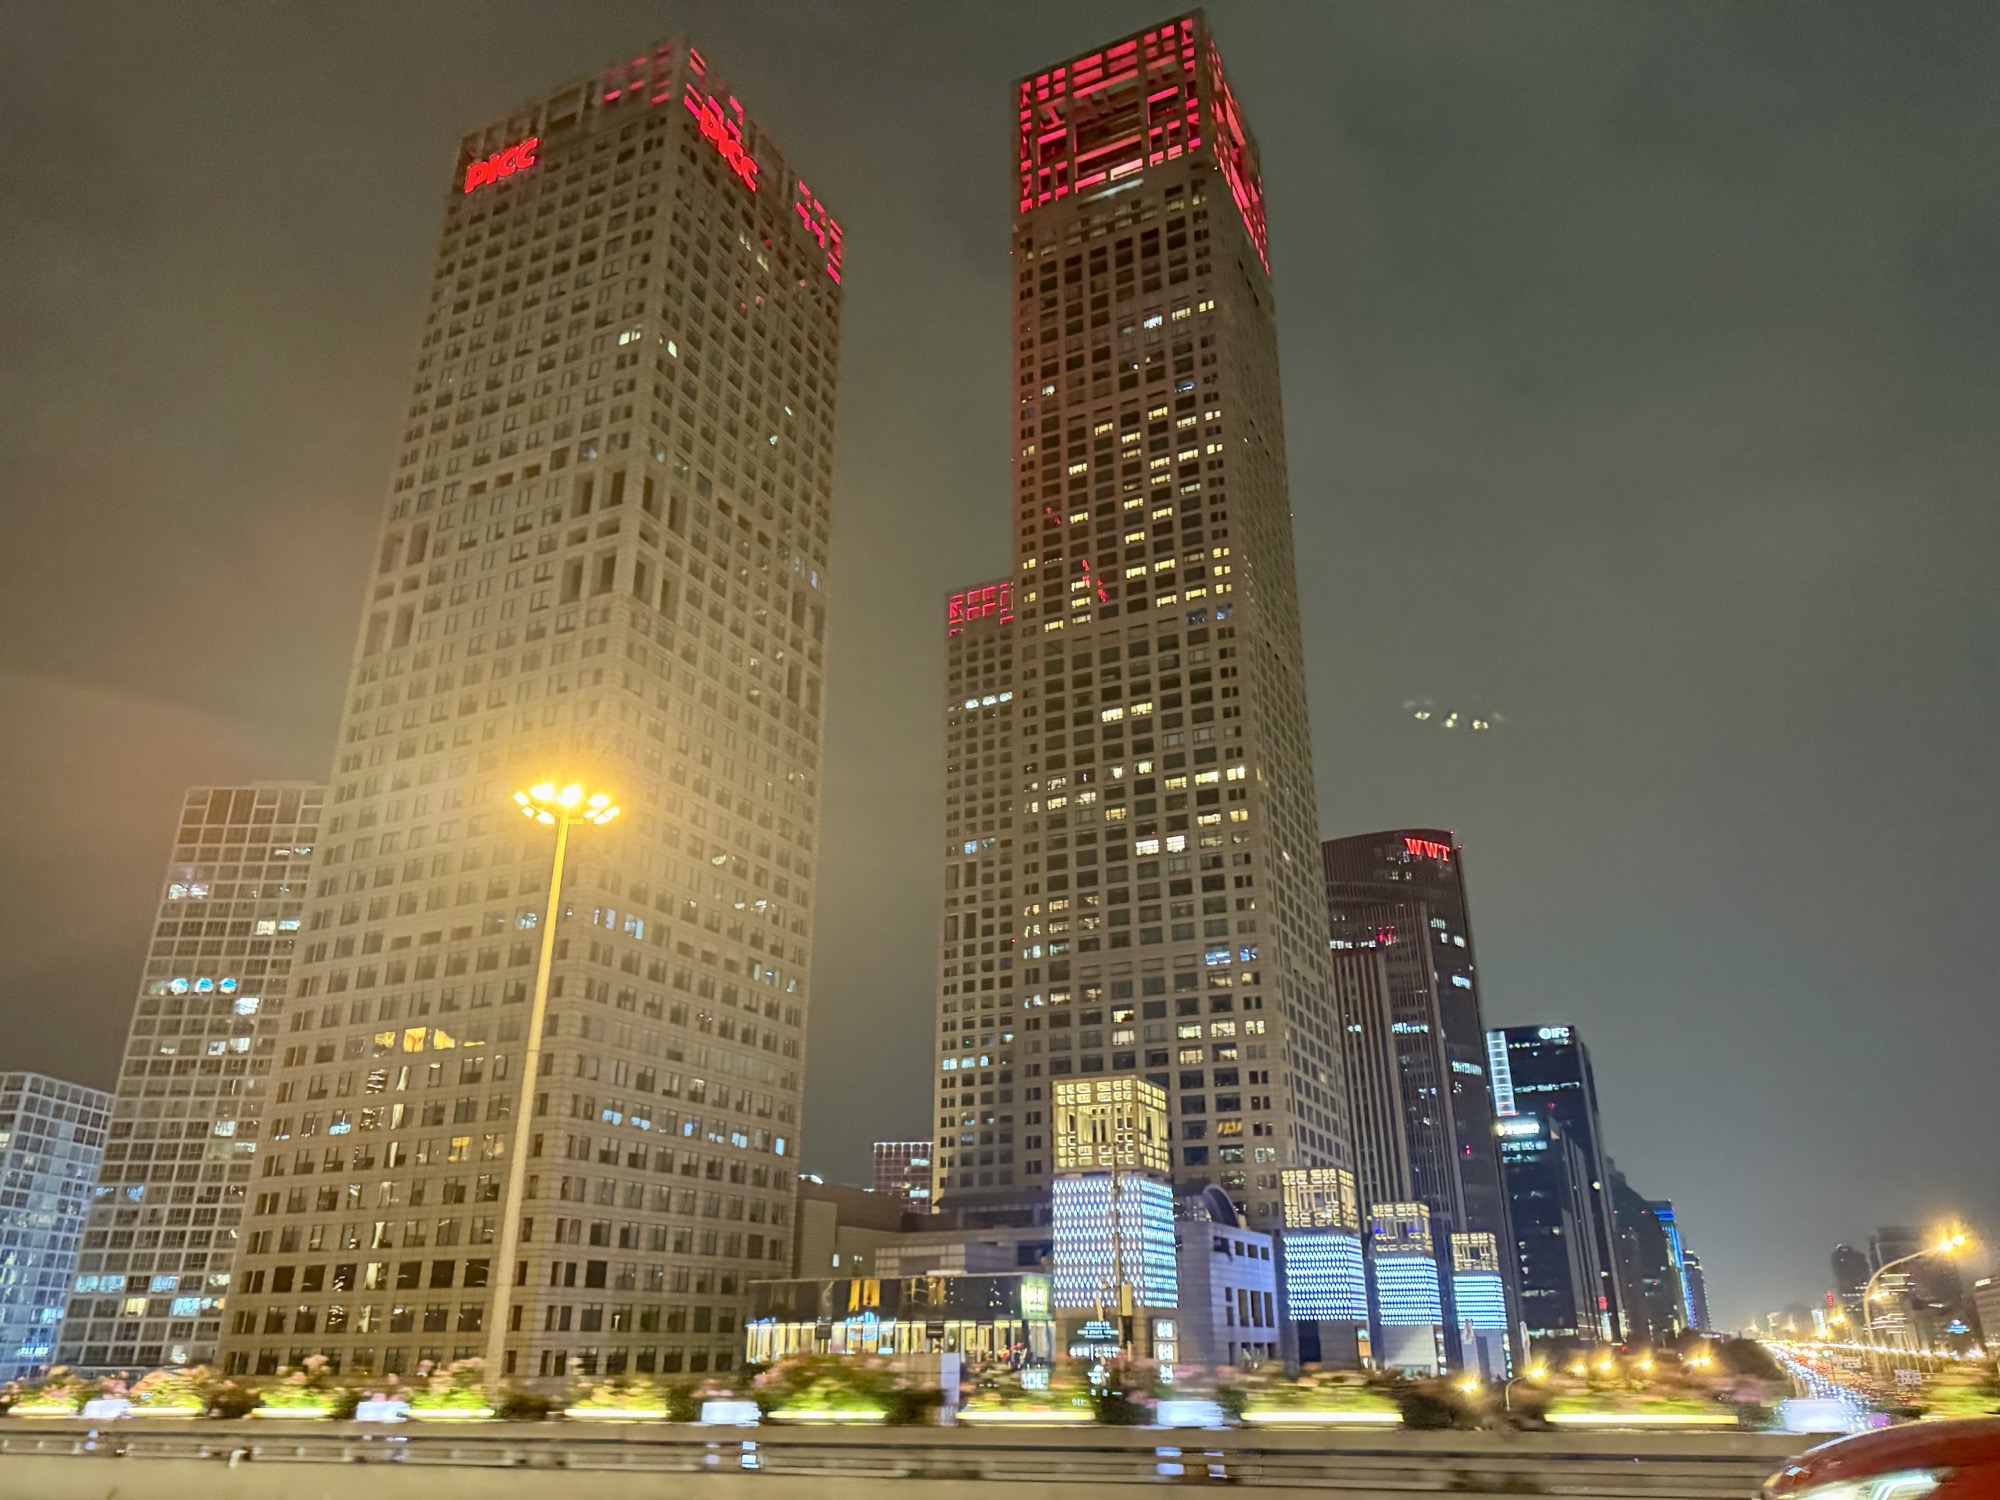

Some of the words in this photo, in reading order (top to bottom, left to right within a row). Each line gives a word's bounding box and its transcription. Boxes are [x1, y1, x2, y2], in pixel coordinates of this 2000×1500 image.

[465, 137, 538, 194] PICC
[700, 103, 758, 192] PICC
[1404, 837, 1450, 862] WWT
[1551, 1027, 1570, 1039] IFC
